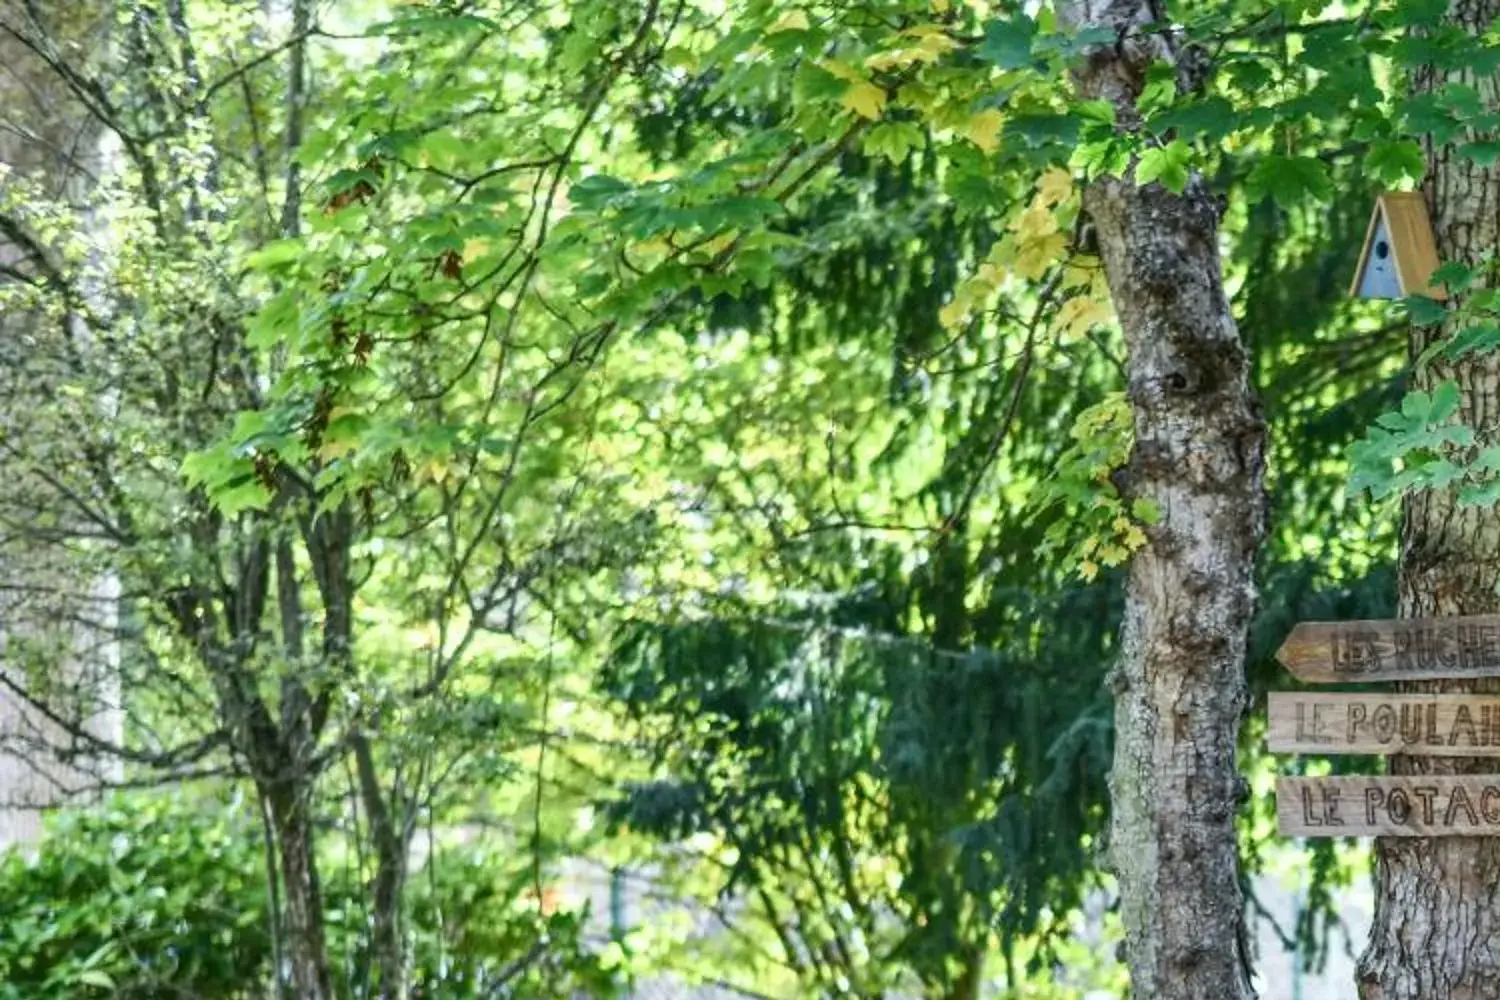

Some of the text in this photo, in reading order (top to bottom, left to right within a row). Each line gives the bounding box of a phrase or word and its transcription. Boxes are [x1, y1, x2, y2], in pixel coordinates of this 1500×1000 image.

[1331, 632, 1381, 672] LES
[1295, 703, 1332, 743] LE
[1302, 787, 1344, 826] LE
